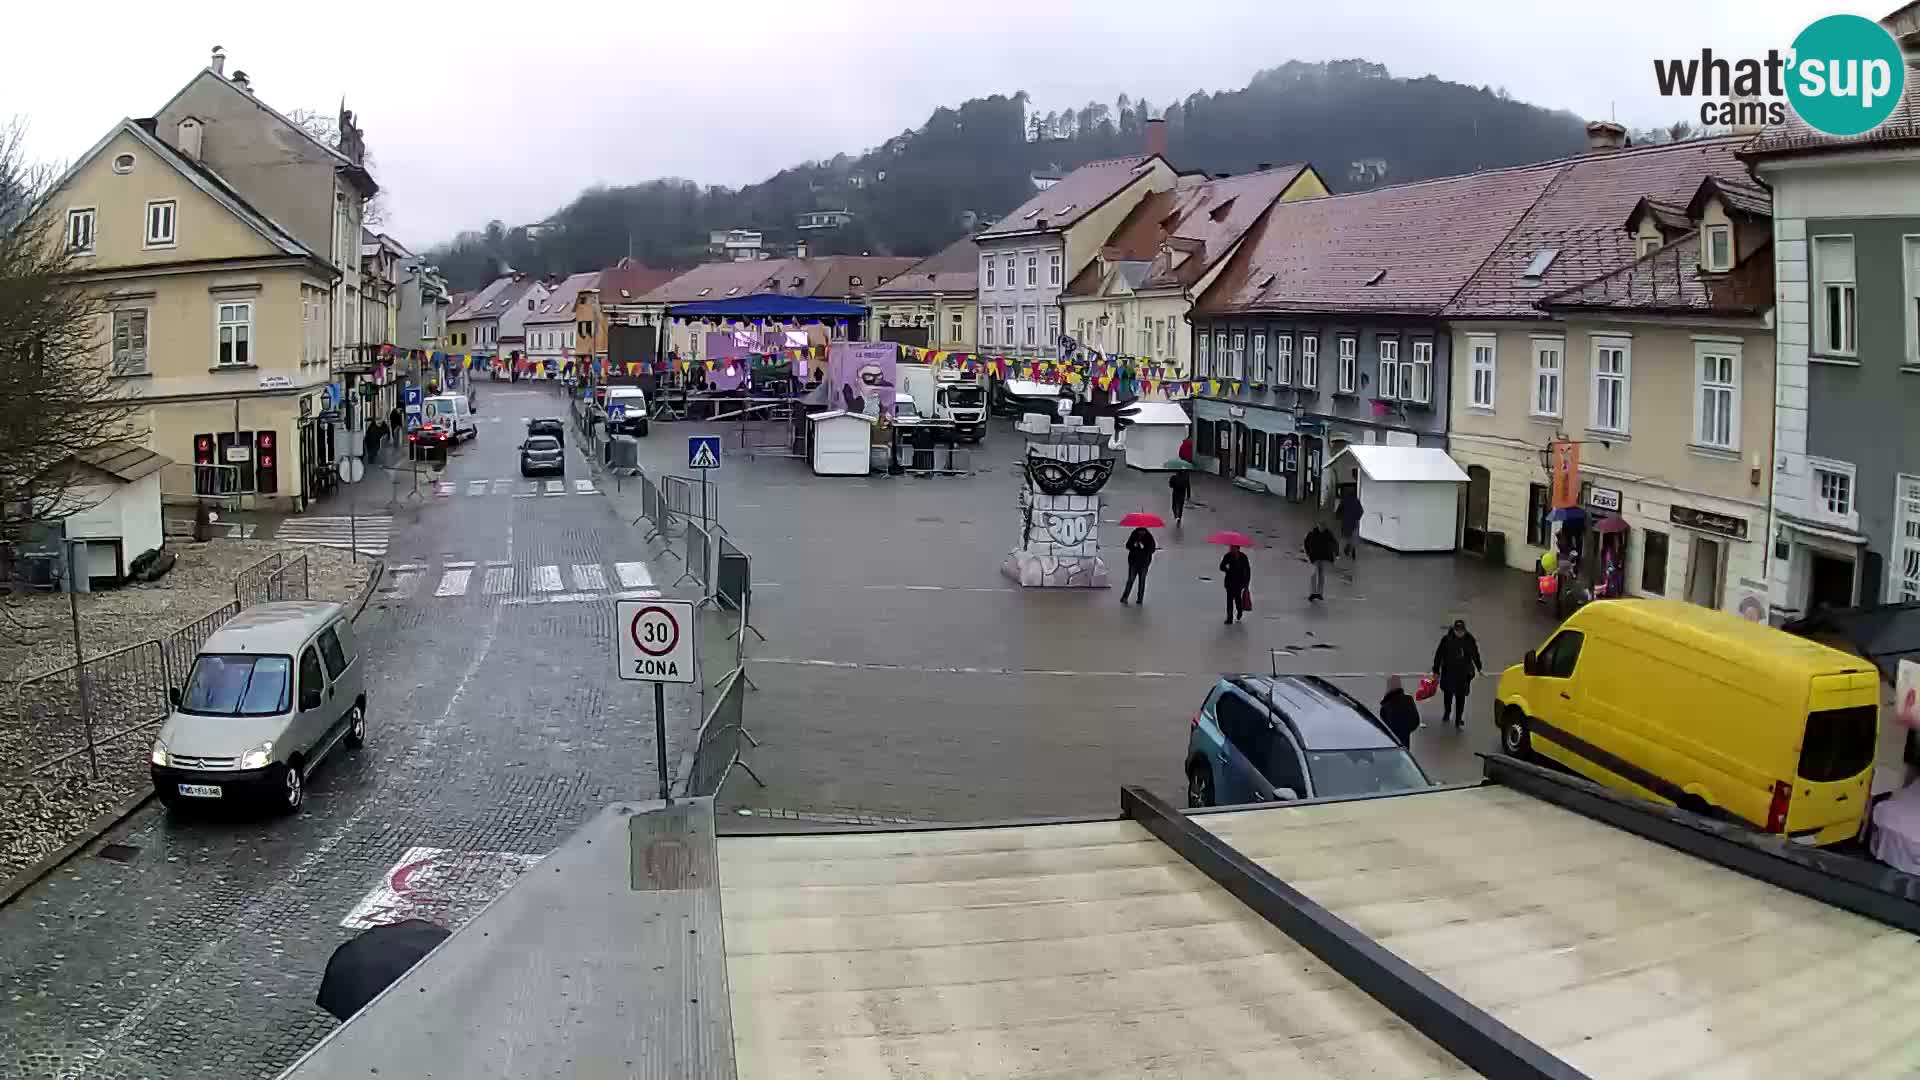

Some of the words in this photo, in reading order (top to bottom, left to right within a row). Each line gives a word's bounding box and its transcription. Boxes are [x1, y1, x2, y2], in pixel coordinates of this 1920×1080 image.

[409, 391, 417, 402] P
[1048, 515, 1088, 546] 200
[644, 622, 668, 643] 30
[634, 659, 679, 676] ZONA
